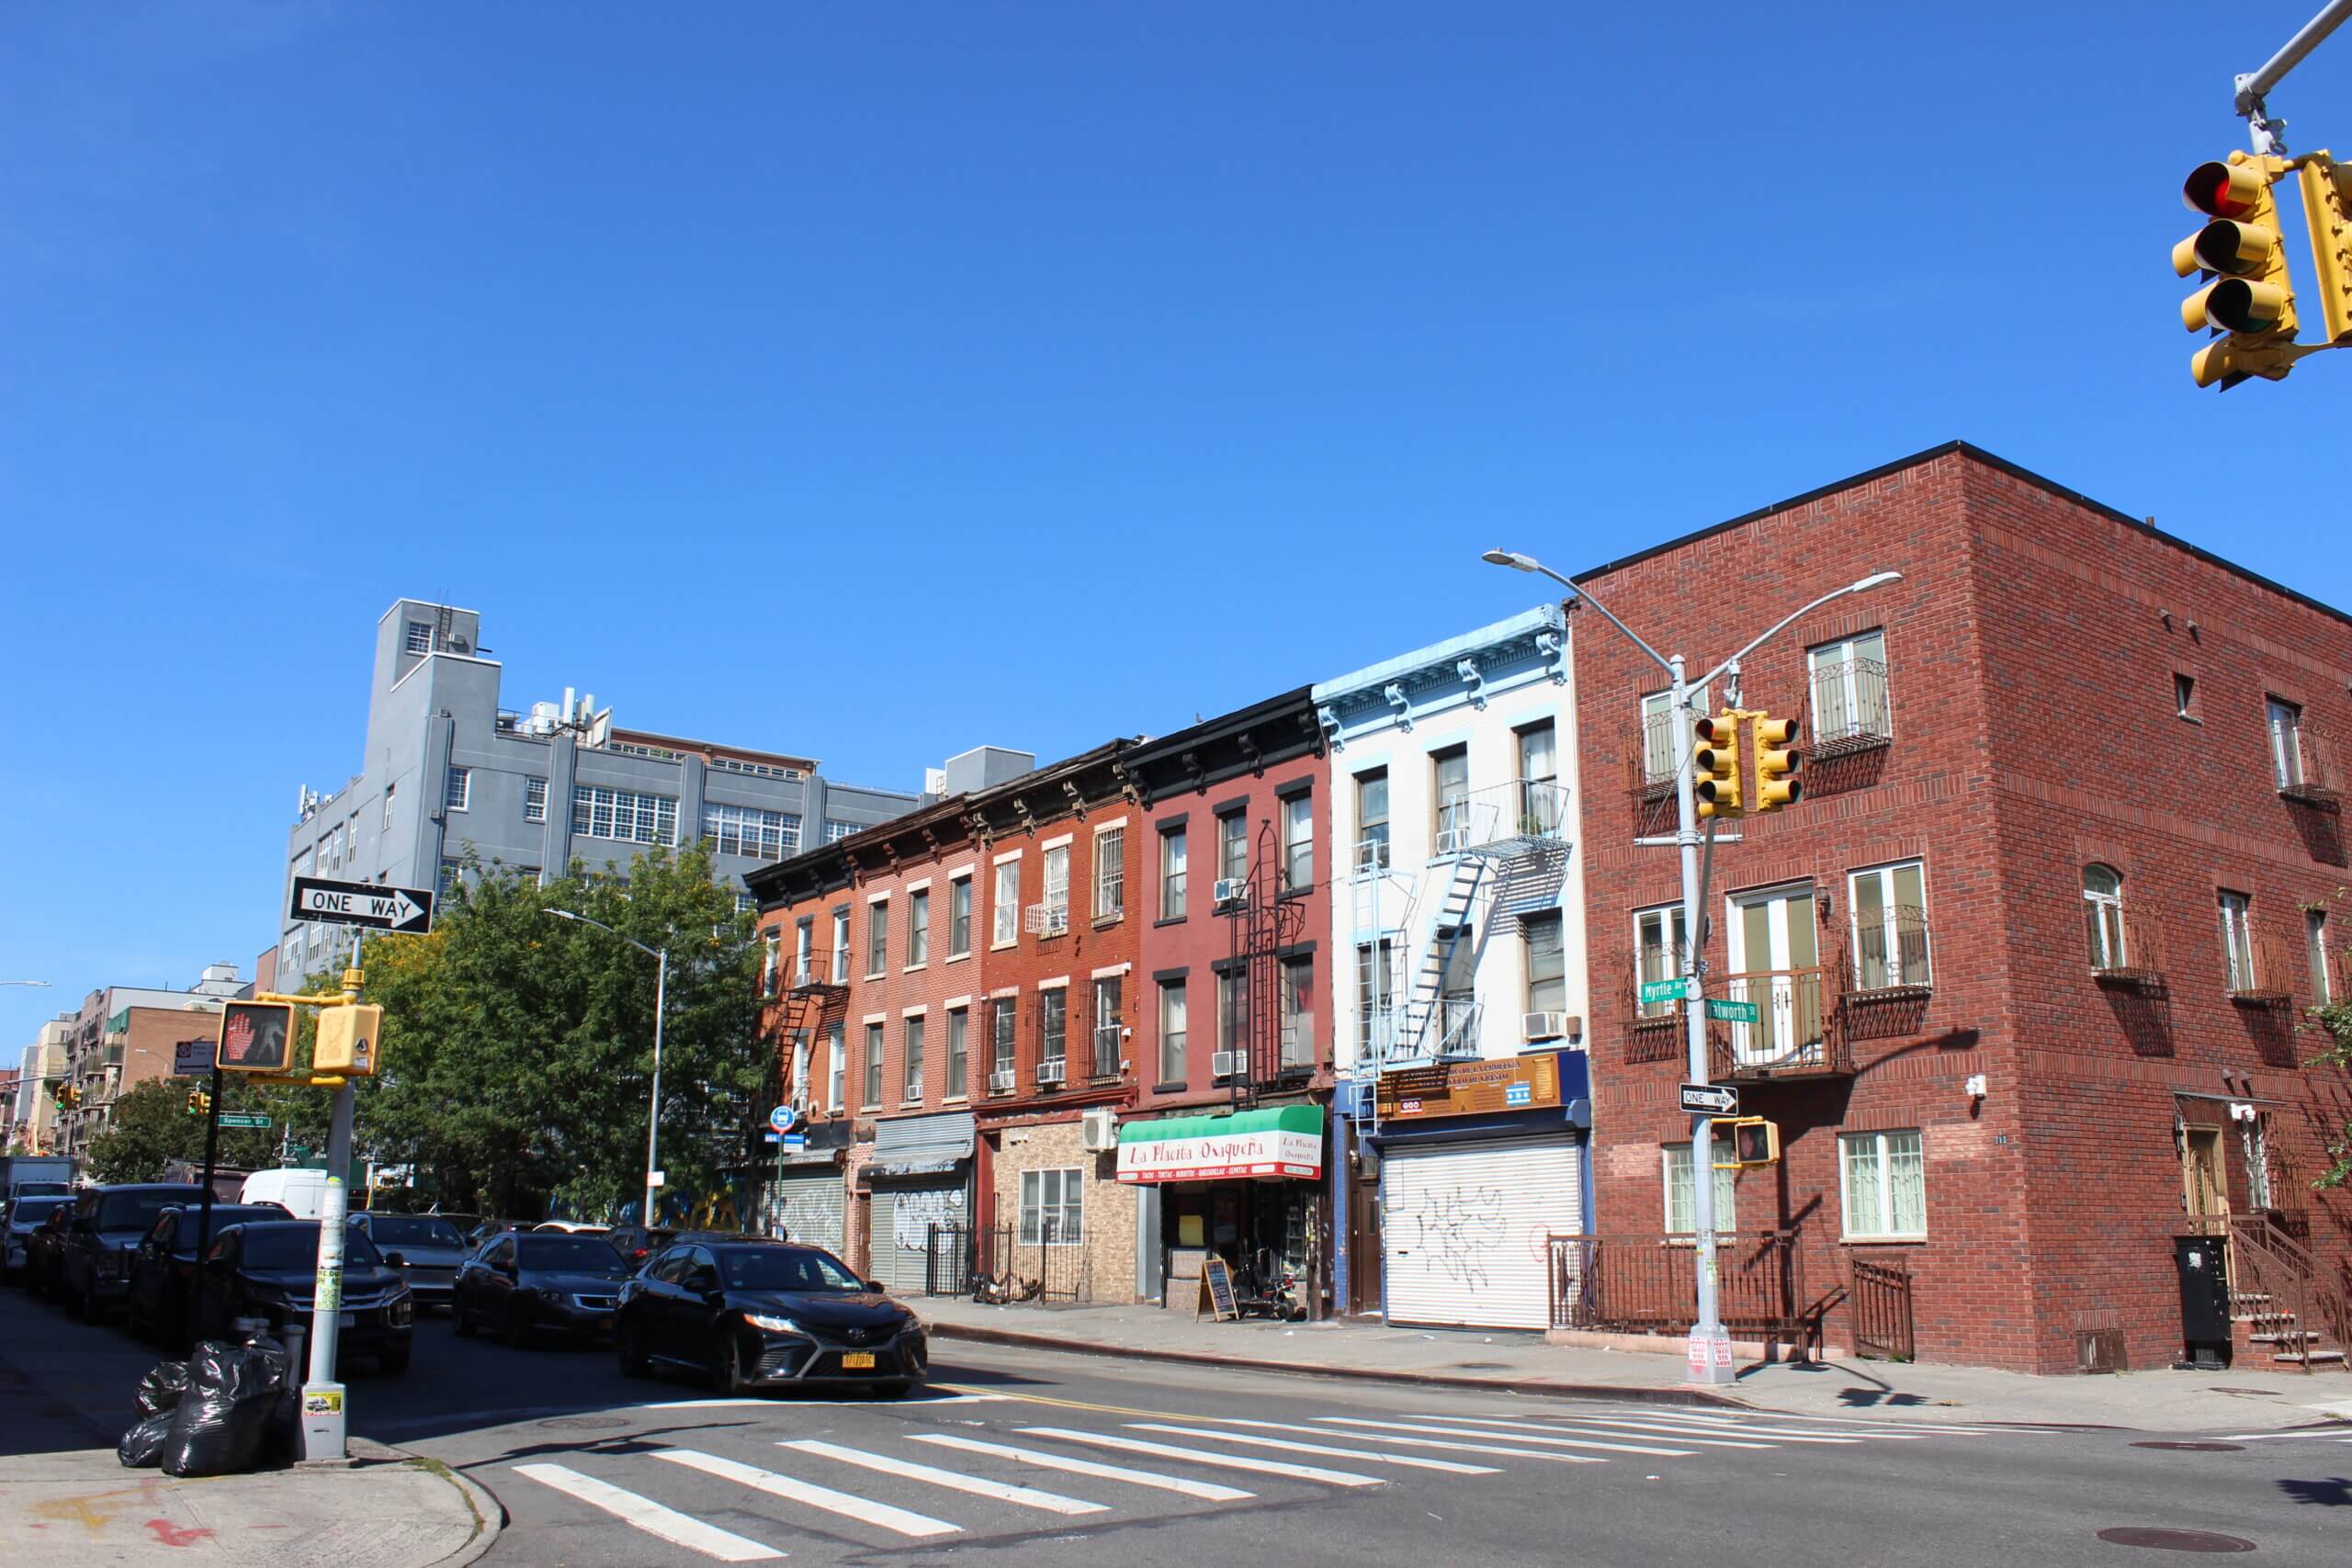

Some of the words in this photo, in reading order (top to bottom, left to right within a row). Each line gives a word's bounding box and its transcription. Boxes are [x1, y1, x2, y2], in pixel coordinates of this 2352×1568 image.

[312, 891, 352, 912] ONE
[371, 898, 411, 918] WAY
[1645, 984, 1672, 998] Myrtle
[1685, 1093, 1705, 1103] ONE
[1713, 1094, 1731, 1105] WAY
[223, 1117, 251, 1125] Spencer
[1283, 1137, 1294, 1146] La
[1296, 1138, 1317, 1149] Placita
[1129, 1146, 1148, 1164] La
[1153, 1142, 1193, 1161] Placita
